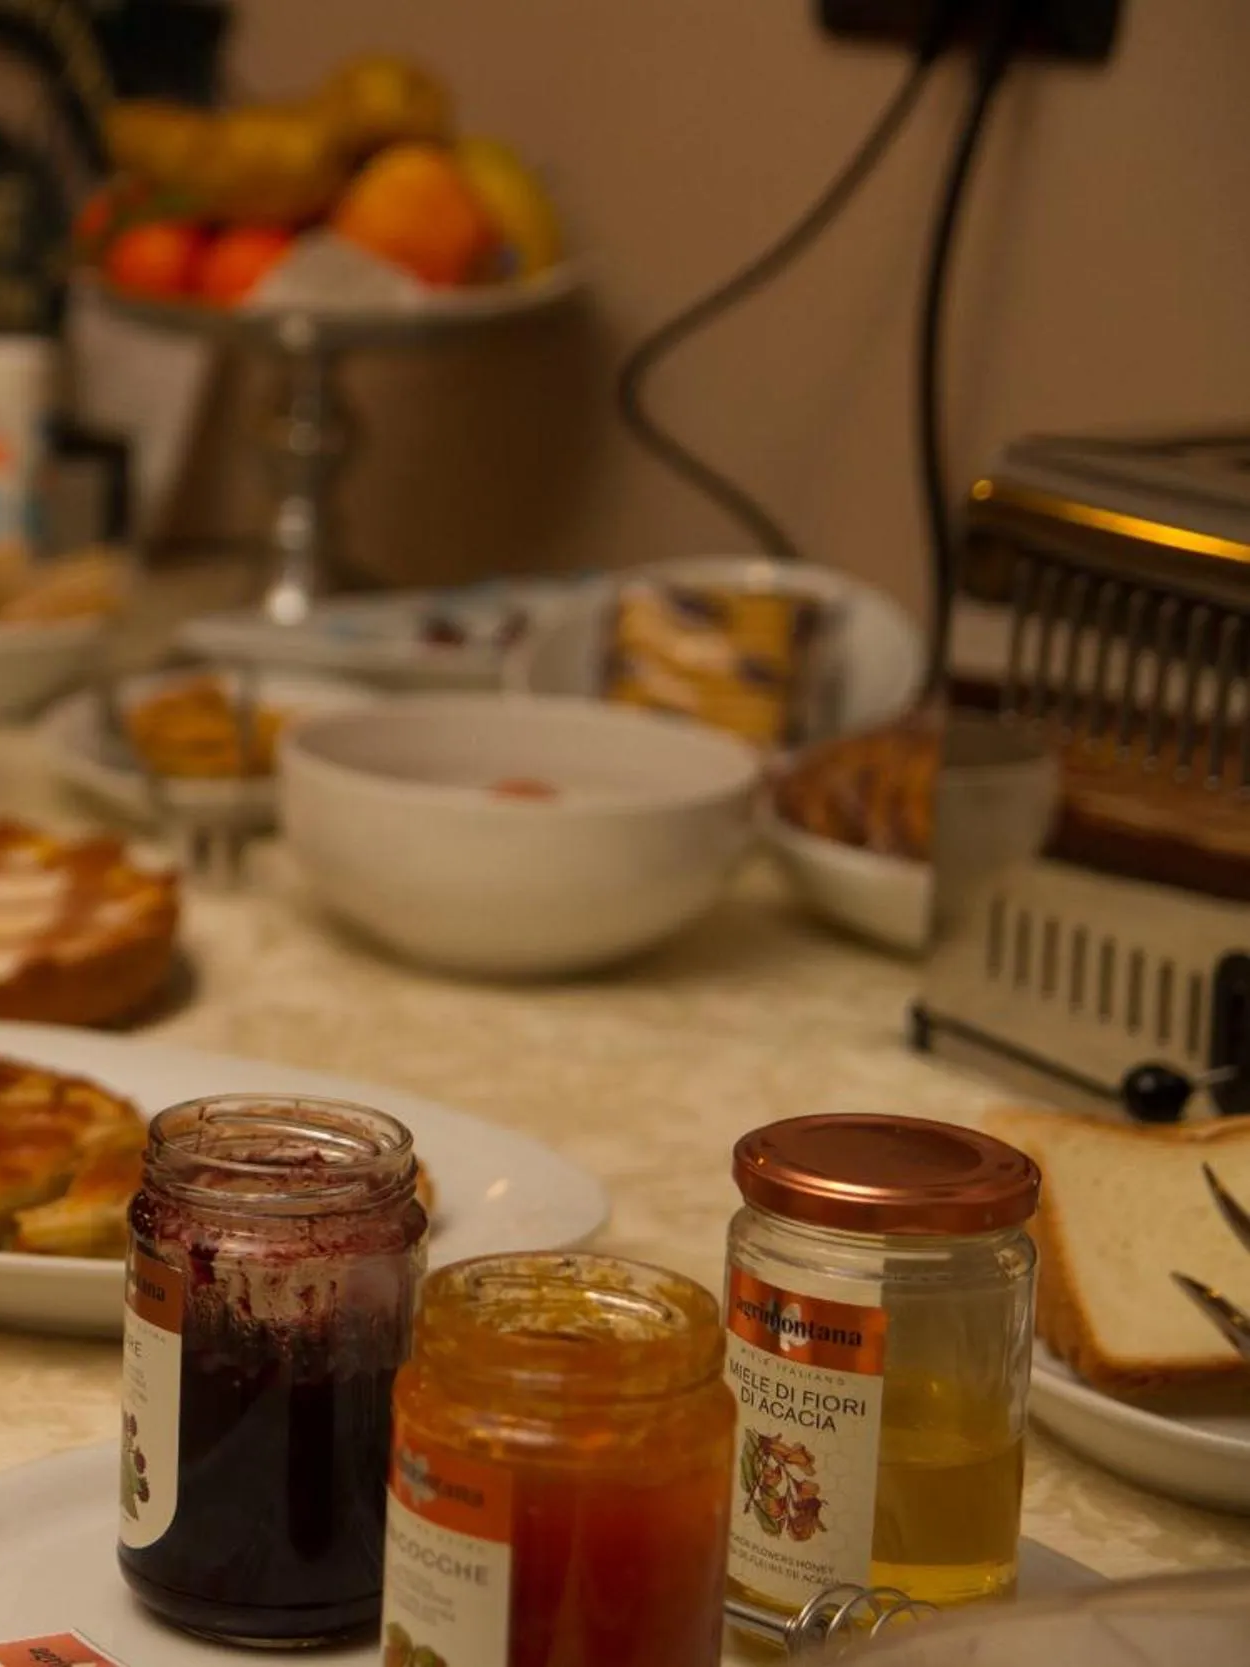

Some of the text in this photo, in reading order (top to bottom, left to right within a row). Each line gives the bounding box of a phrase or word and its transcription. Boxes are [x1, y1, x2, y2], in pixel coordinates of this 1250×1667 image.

[730, 1359, 866, 1417] MIELE DI FIORI
[741, 1386, 836, 1433] DI ACACIA
